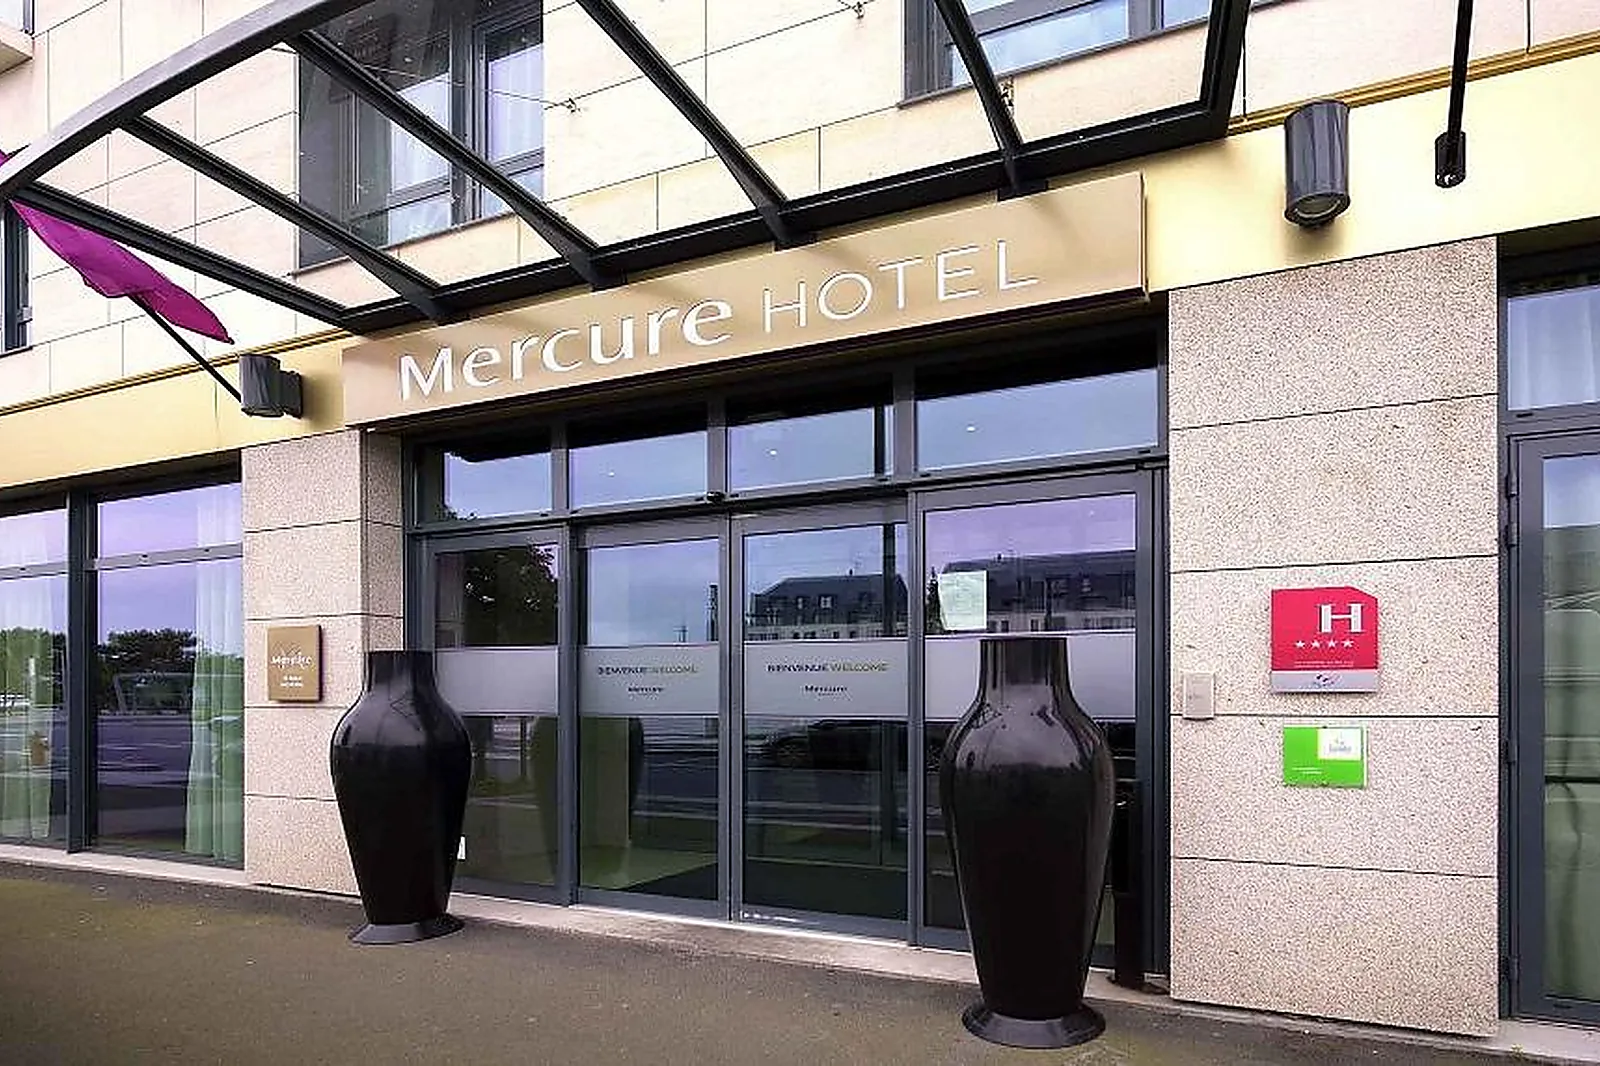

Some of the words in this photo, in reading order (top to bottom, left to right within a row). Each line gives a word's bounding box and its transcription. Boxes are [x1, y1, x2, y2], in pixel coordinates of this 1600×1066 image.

[399, 297, 733, 402] Mercure
[762, 238, 1039, 334] HOTEL
[1317, 603, 1365, 634] H
[829, 662, 889, 672] WELCOME
